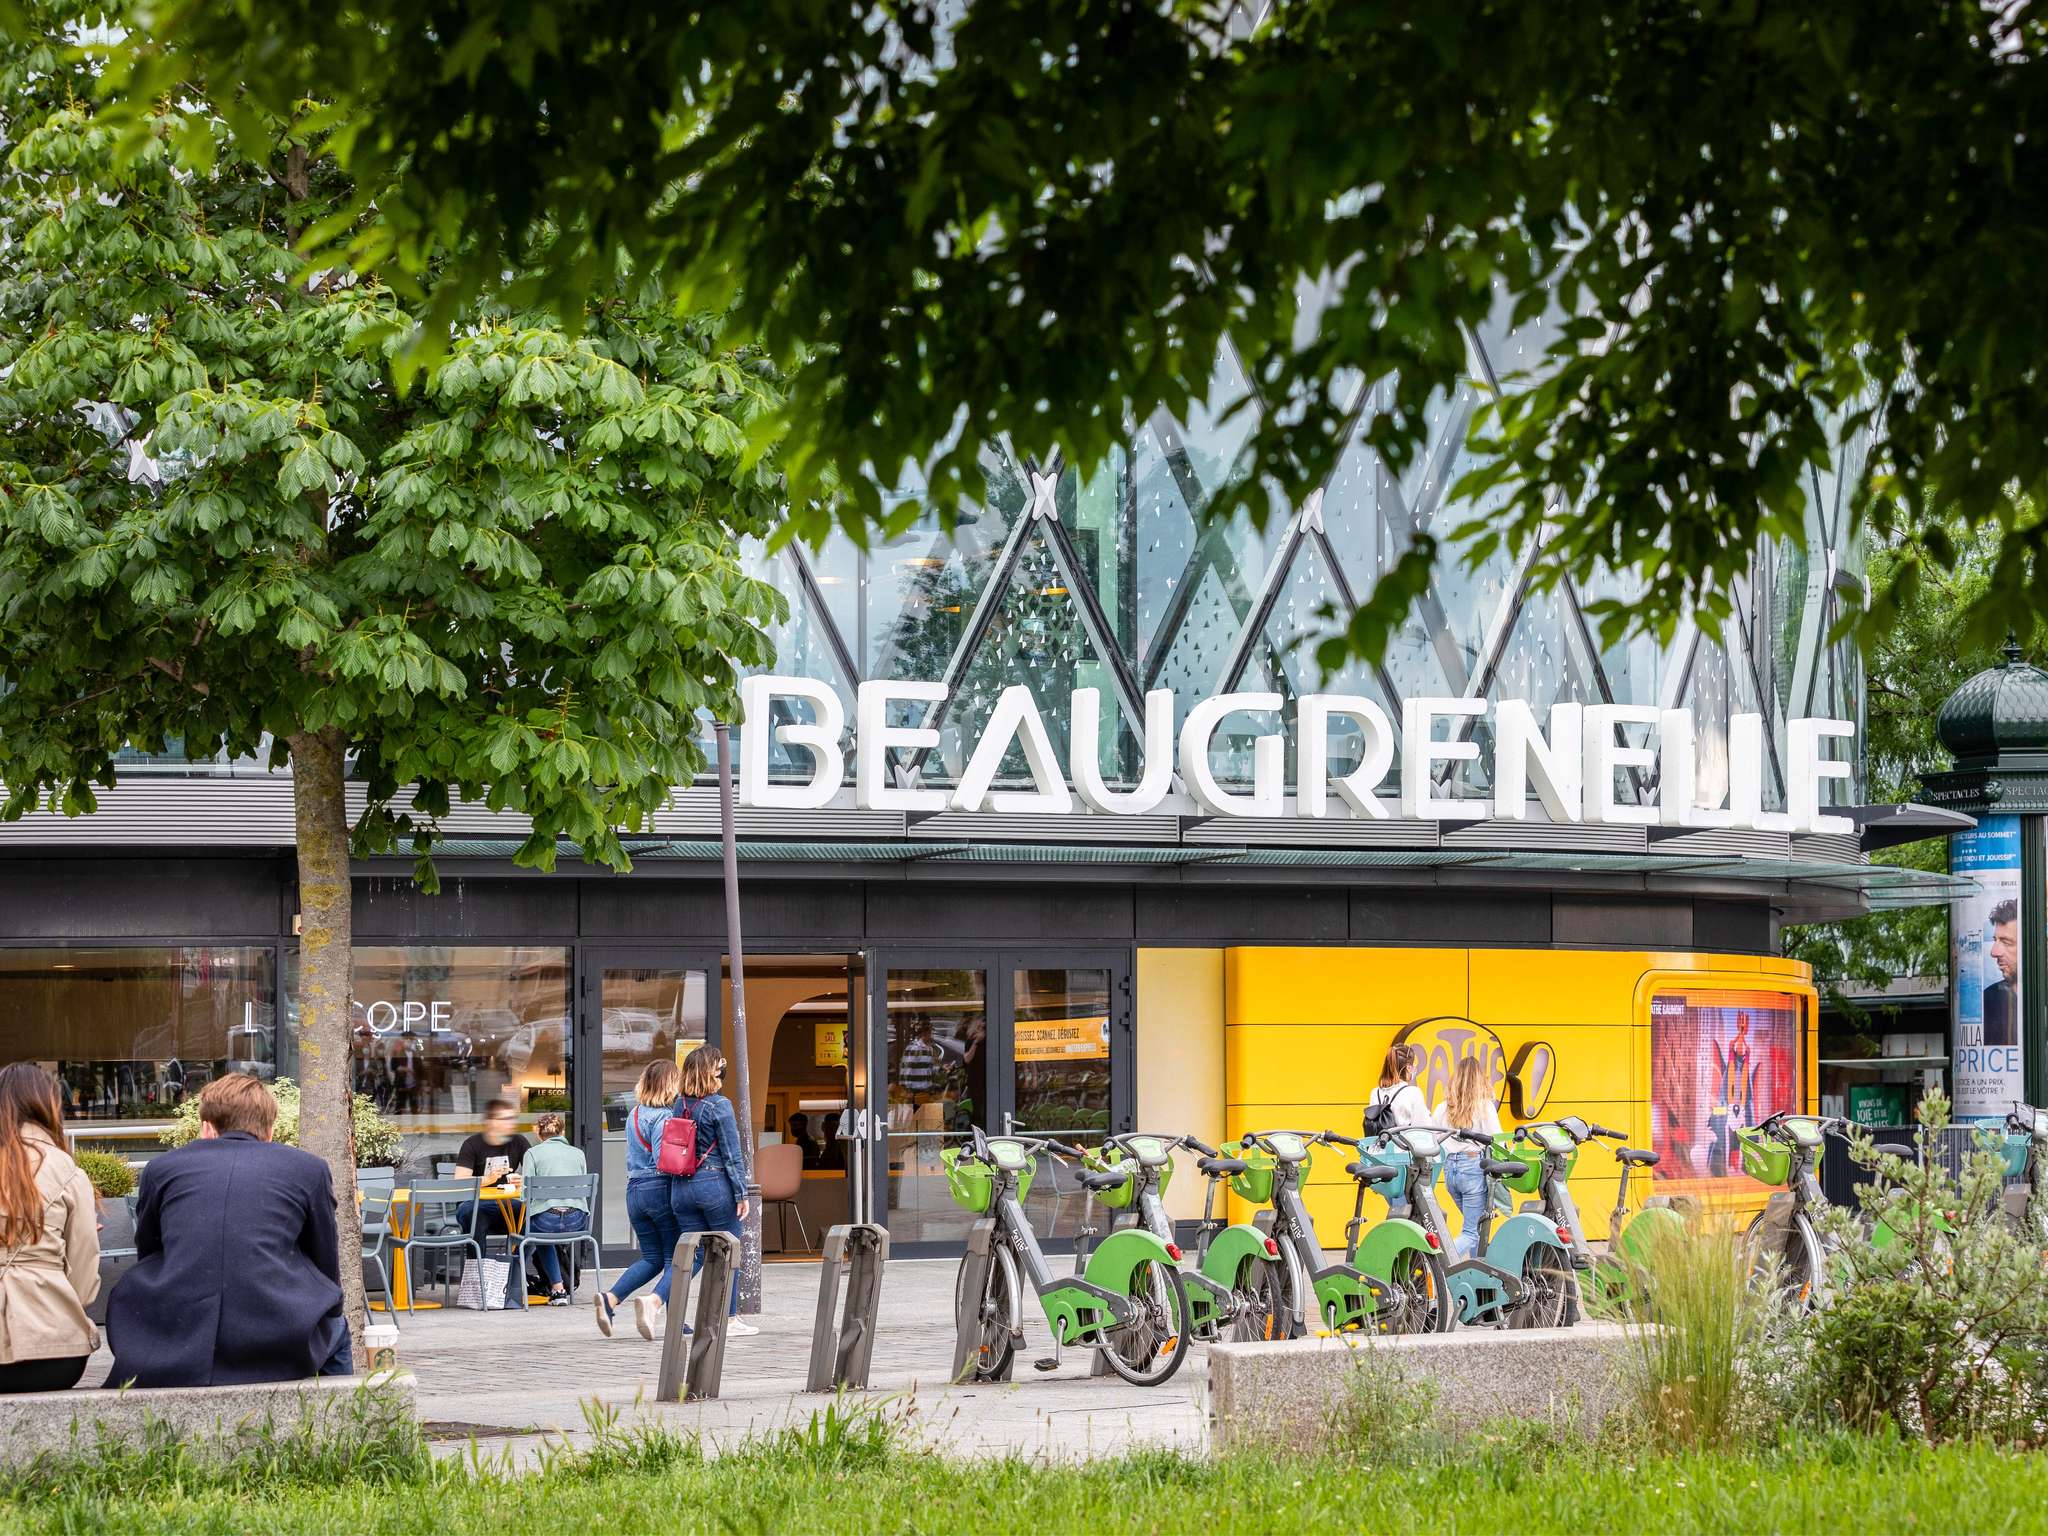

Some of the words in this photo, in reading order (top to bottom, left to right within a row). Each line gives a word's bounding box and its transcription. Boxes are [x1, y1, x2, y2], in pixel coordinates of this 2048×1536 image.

[739, 674, 1855, 835] BEAUGRENELLE
[1933, 788, 1981, 801] SPECTACLES
[1970, 1087, 1977, 1095] LE
[1977, 1086, 1998, 1095] VÔTRE
[1856, 1109, 1873, 1122] JOIE
